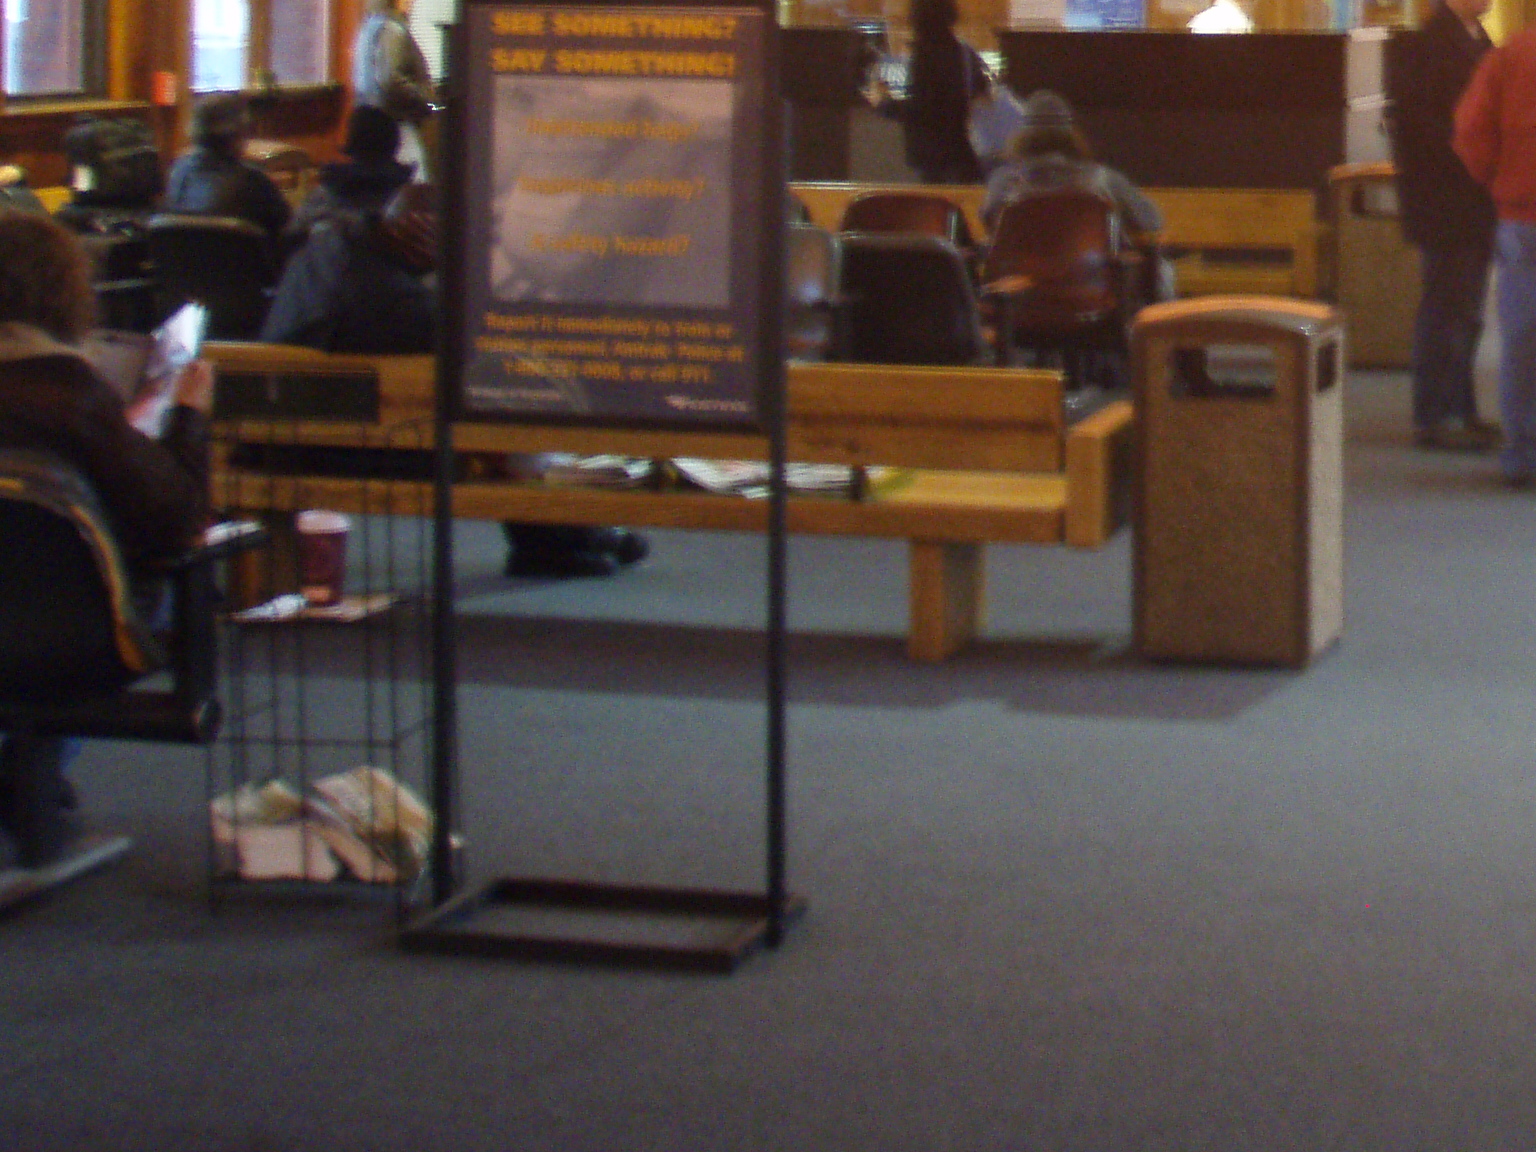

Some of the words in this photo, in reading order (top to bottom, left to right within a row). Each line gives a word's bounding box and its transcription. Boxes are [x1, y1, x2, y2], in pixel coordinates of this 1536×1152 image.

[493, 12, 546, 36] SEE
[552, 13, 738, 39] SOMETHING?
[491, 49, 547, 72] SAY
